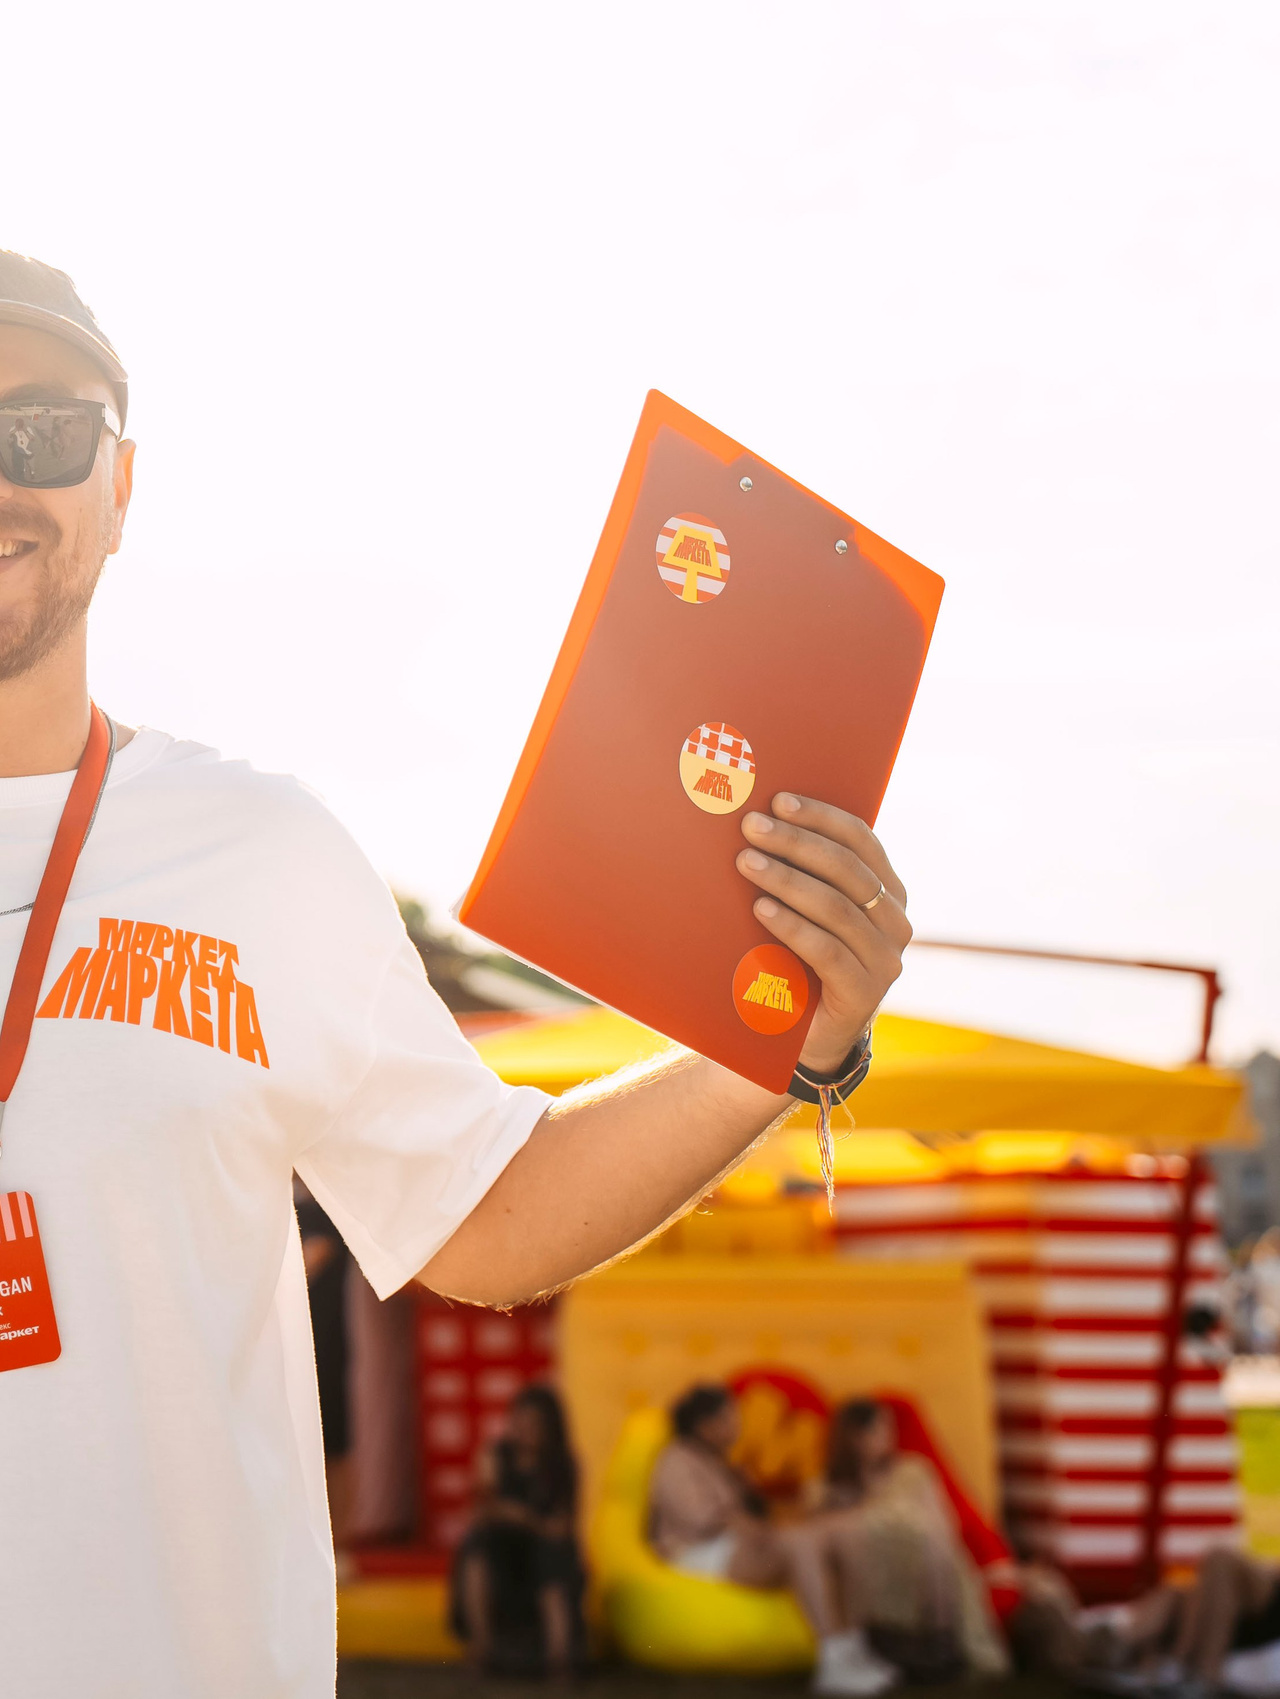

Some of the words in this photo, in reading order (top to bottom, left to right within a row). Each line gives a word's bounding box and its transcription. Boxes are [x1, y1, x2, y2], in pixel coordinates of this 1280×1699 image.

[98, 917, 240, 977] МАРКЕТ
[34, 946, 270, 1070] МАРКЕТА
[742, 980, 794, 1014] МАРКЕТА
